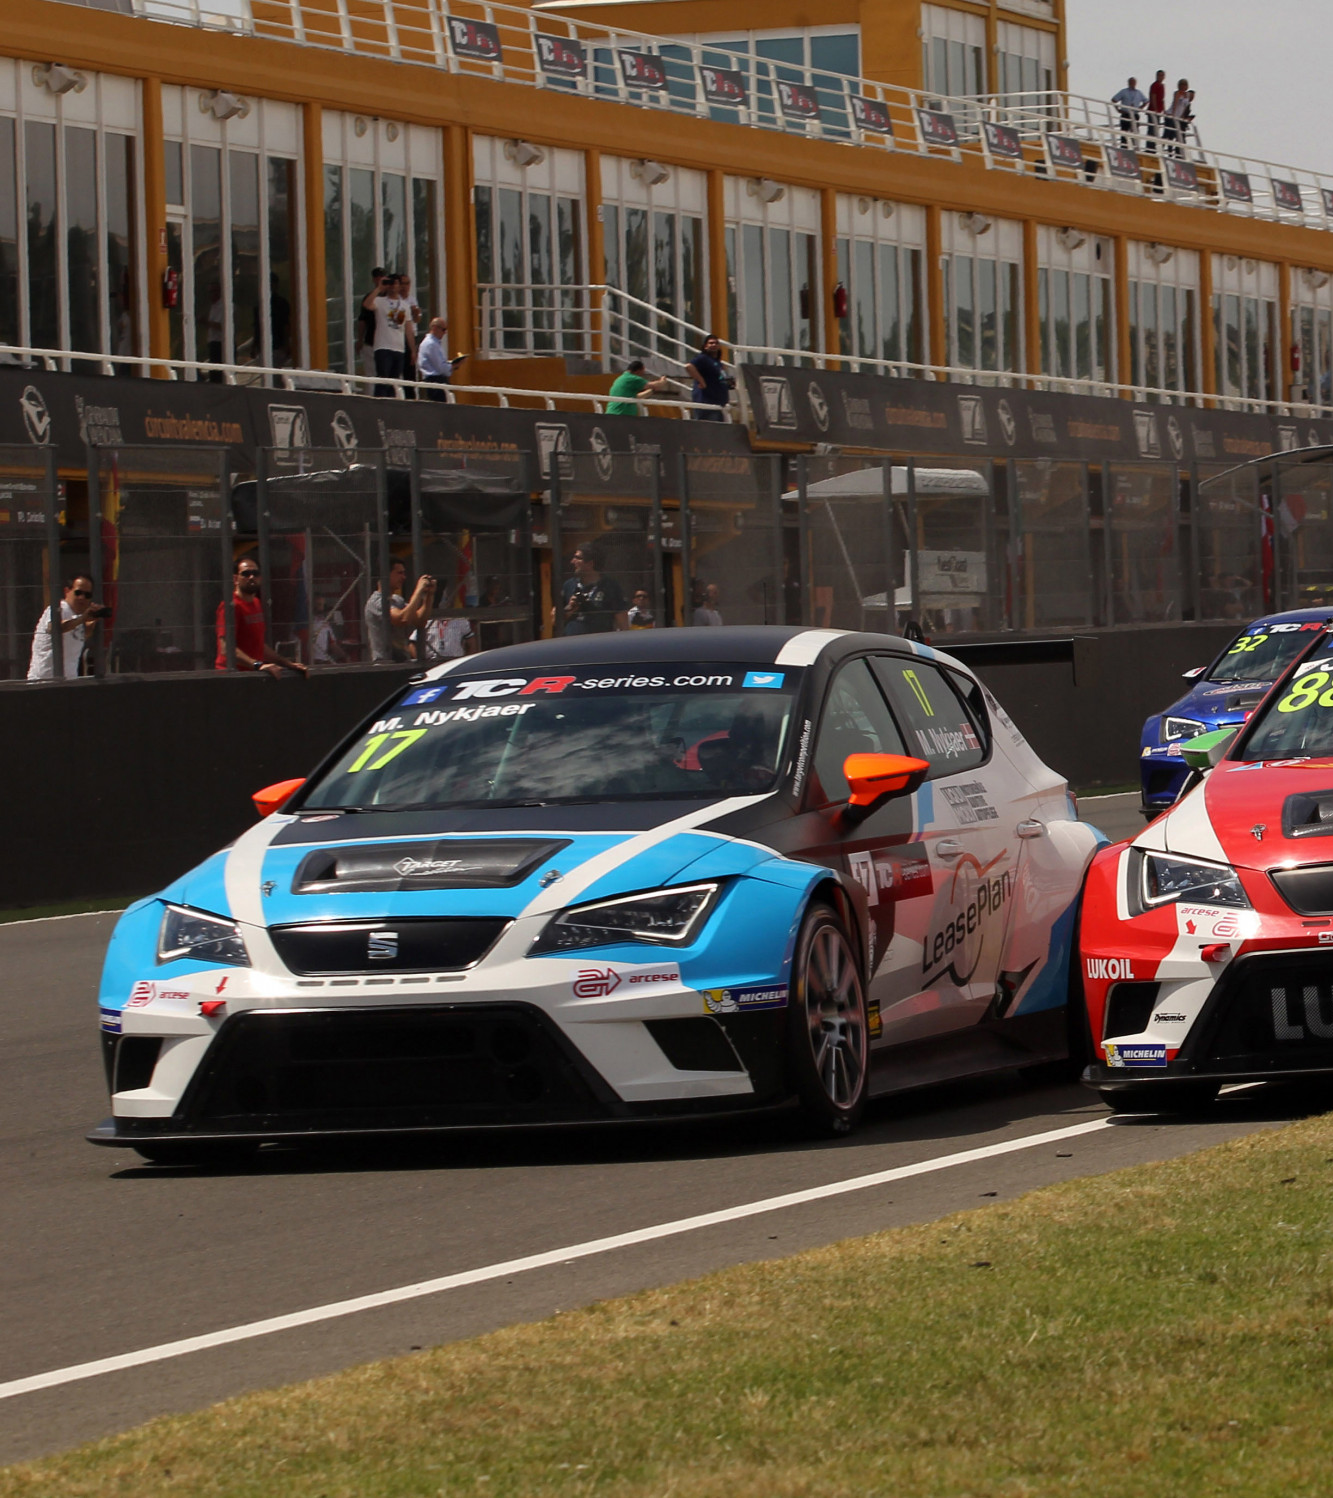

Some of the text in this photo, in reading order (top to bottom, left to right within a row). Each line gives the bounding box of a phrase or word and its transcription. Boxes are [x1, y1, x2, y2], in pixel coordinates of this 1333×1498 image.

[1228, 634, 1269, 655] 32
[368, 702, 536, 735] M. Nykjaer
[347, 728, 428, 774] 17
[922, 870, 1011, 974] LeasePlan
[1180, 906, 1220, 917] arcese
[629, 971, 679, 984] arcese
[1086, 958, 1135, 979] LUKOIL
[1122, 1049, 1166, 1059] MICHELIN
